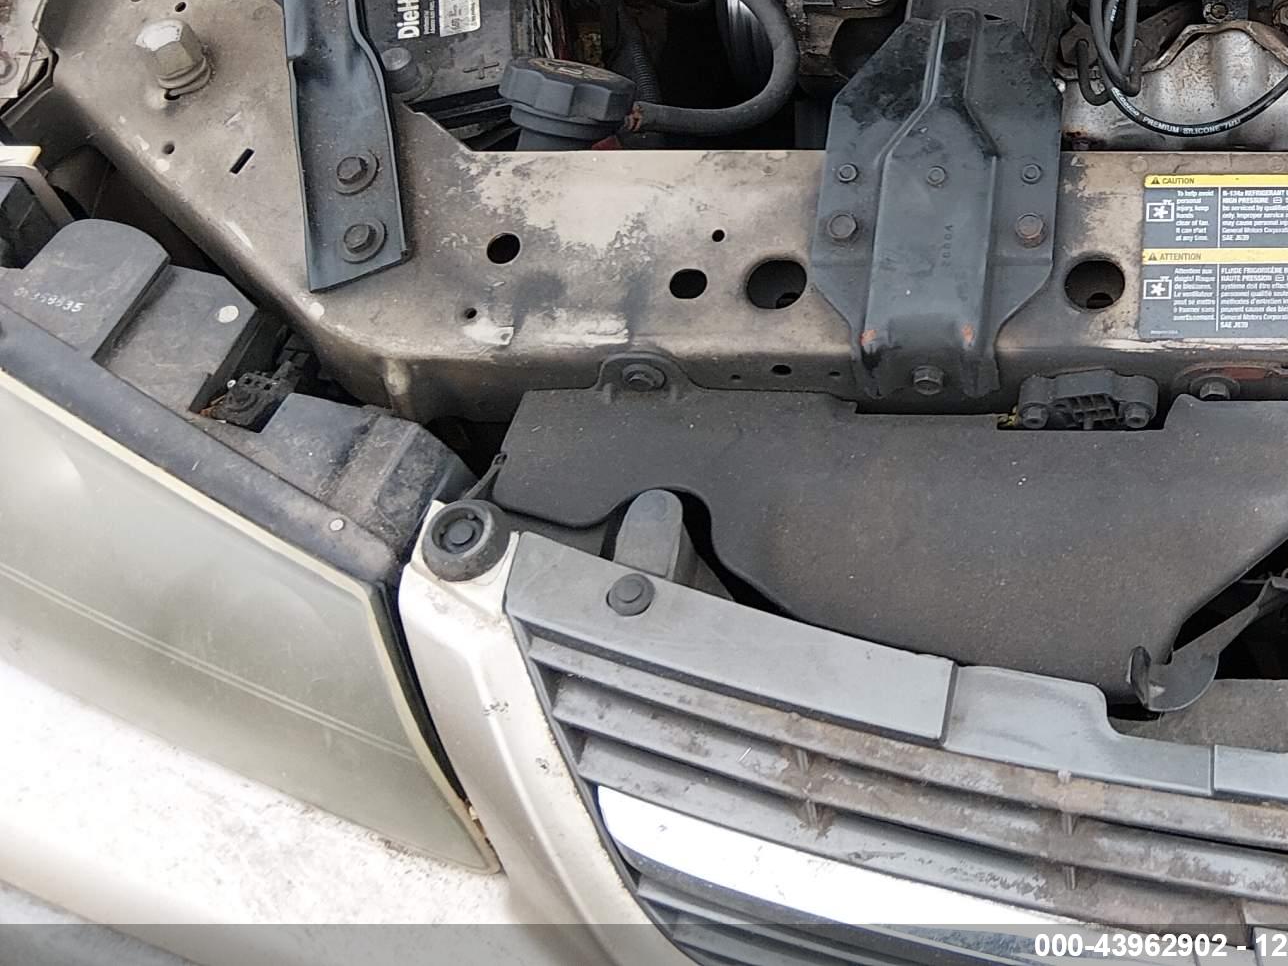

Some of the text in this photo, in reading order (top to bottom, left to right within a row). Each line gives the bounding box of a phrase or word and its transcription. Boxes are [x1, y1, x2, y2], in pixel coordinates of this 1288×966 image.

[1141, 116, 1180, 134] PREMIUM
[1182, 125, 1220, 135] SILICONE
[1162, 177, 1195, 185] CAUTION
[1159, 253, 1201, 261] ATTENTION
